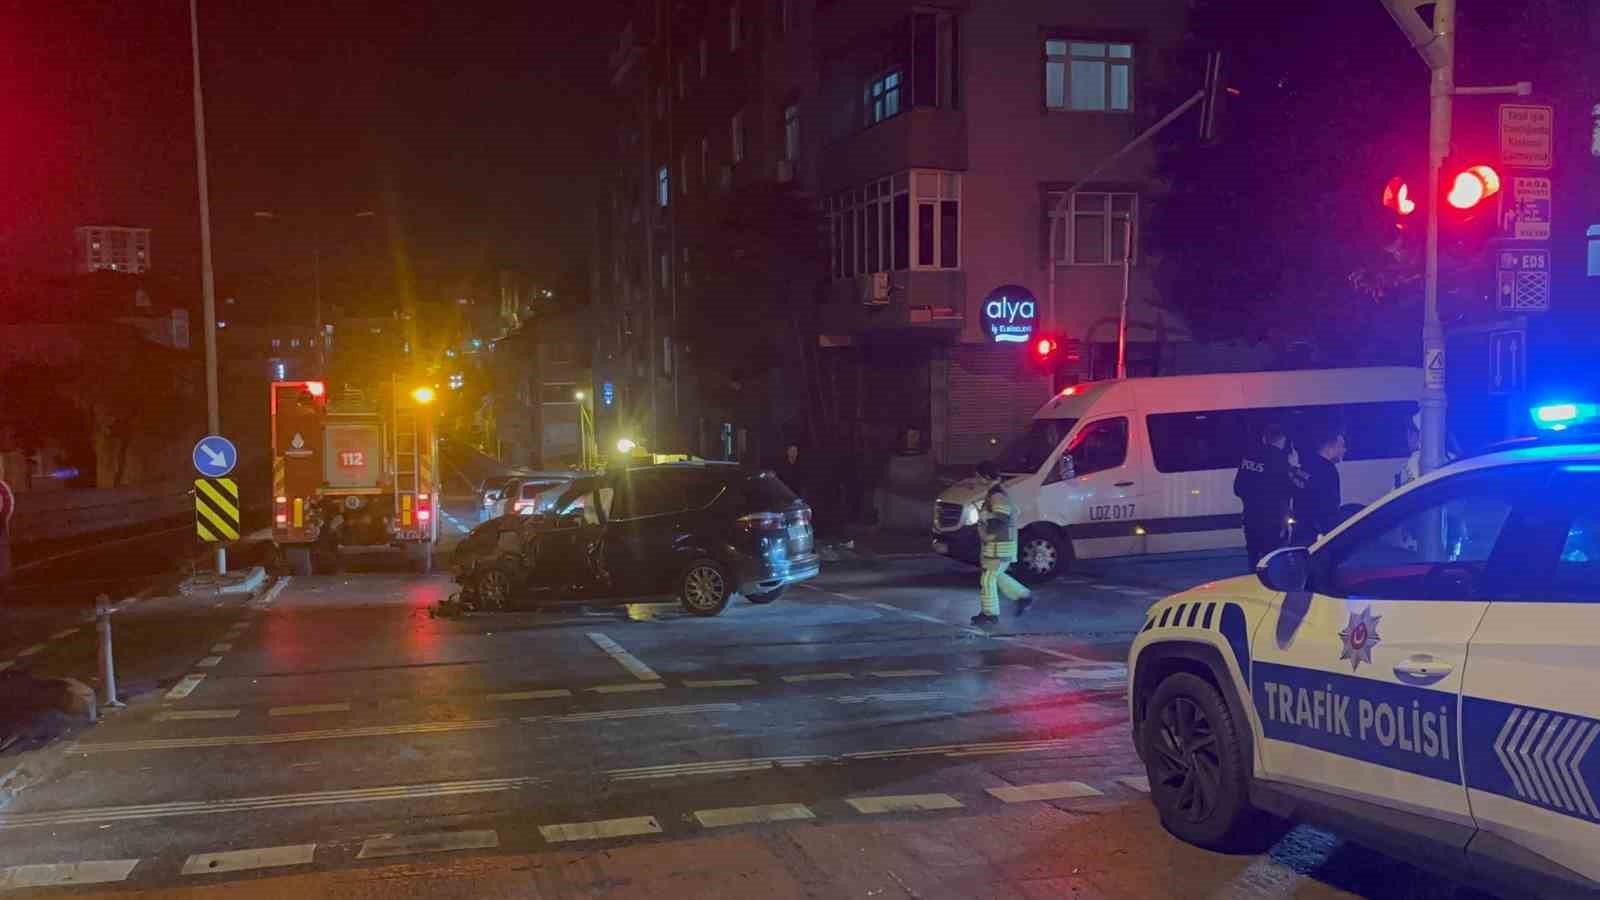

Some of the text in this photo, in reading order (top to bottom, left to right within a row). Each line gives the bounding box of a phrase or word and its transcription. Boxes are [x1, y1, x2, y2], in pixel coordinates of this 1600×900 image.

[1522, 255, 1545, 269] EDS
[986, 296, 1034, 324] alya
[341, 452, 364, 466] 112
[1264, 682, 1450, 760] TRAFİK POLİSİ
